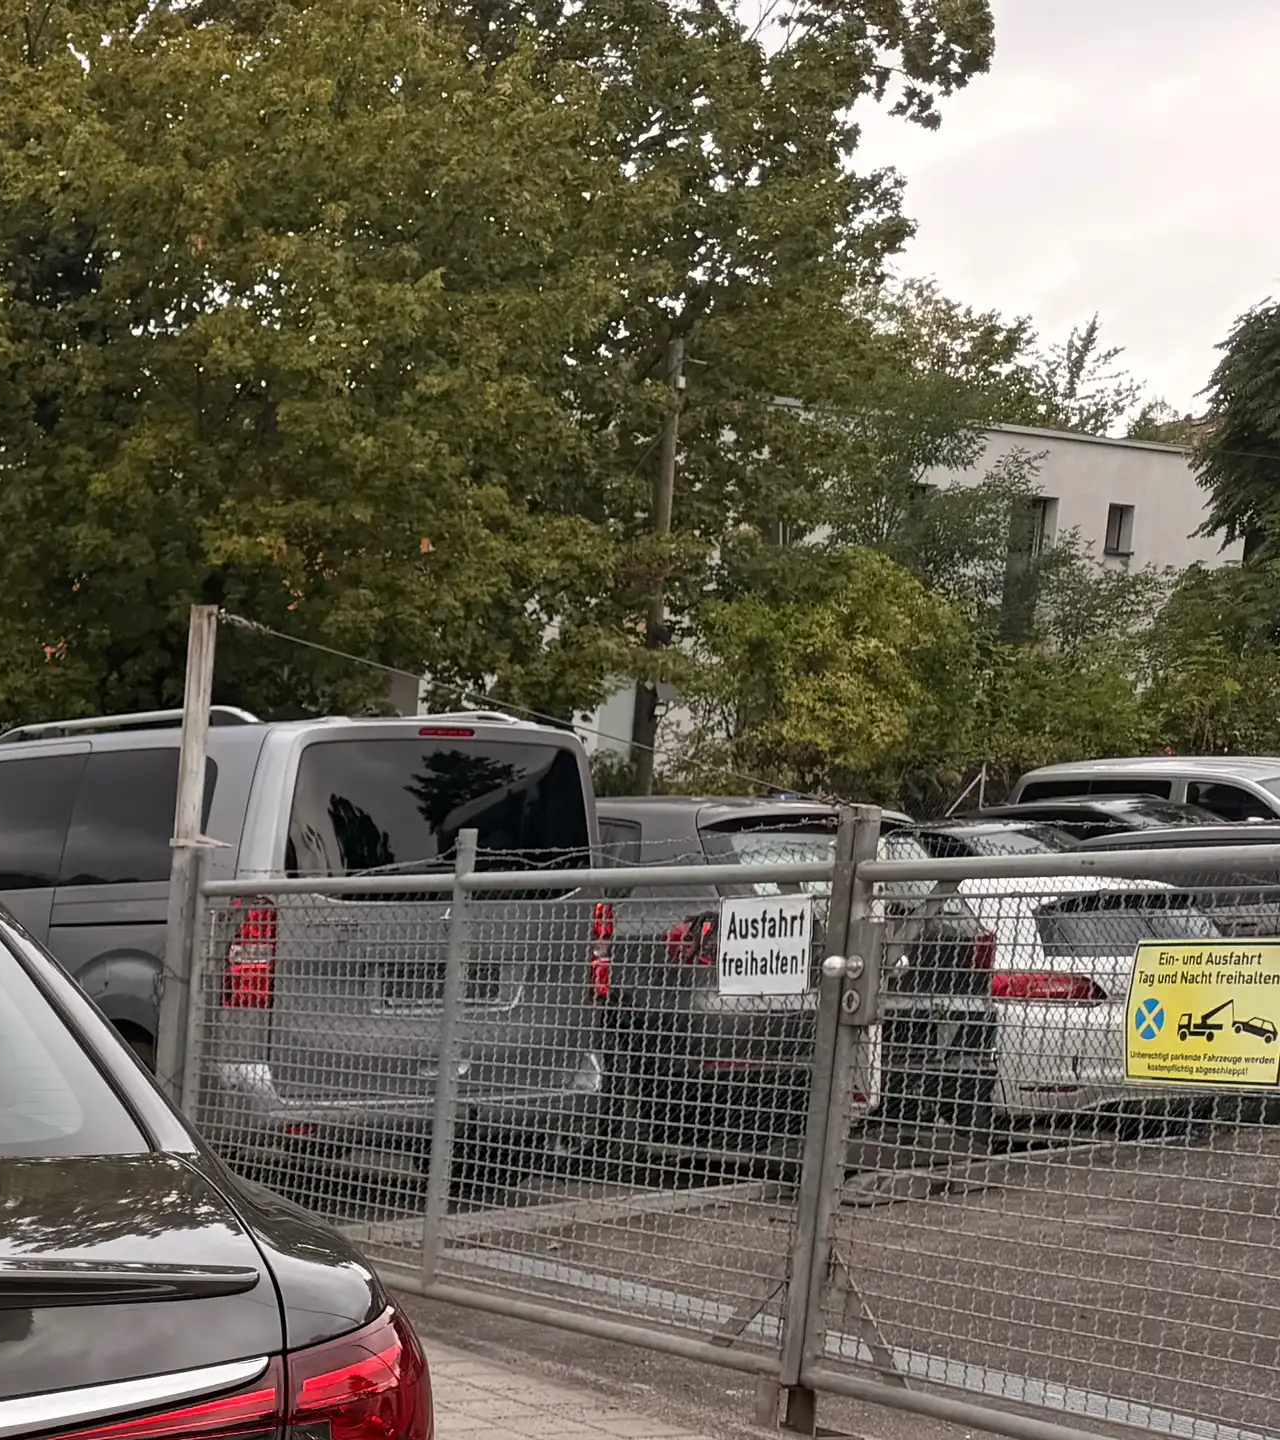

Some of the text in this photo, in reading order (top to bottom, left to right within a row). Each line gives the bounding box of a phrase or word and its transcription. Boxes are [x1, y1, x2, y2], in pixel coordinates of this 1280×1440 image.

[726, 908, 805, 940] Ausfahrt
[722, 948, 806, 976] freihalten!
[1158, 951, 1262, 966] Ein- und Ausfahrt
[1138, 970, 1280, 987] Tag und Nacht freihalten
[1130, 1051, 1275, 1065] Unberechtigt parkende Fahrzeuge werden
[1147, 1062, 1194, 1075] kostenpflichtig
